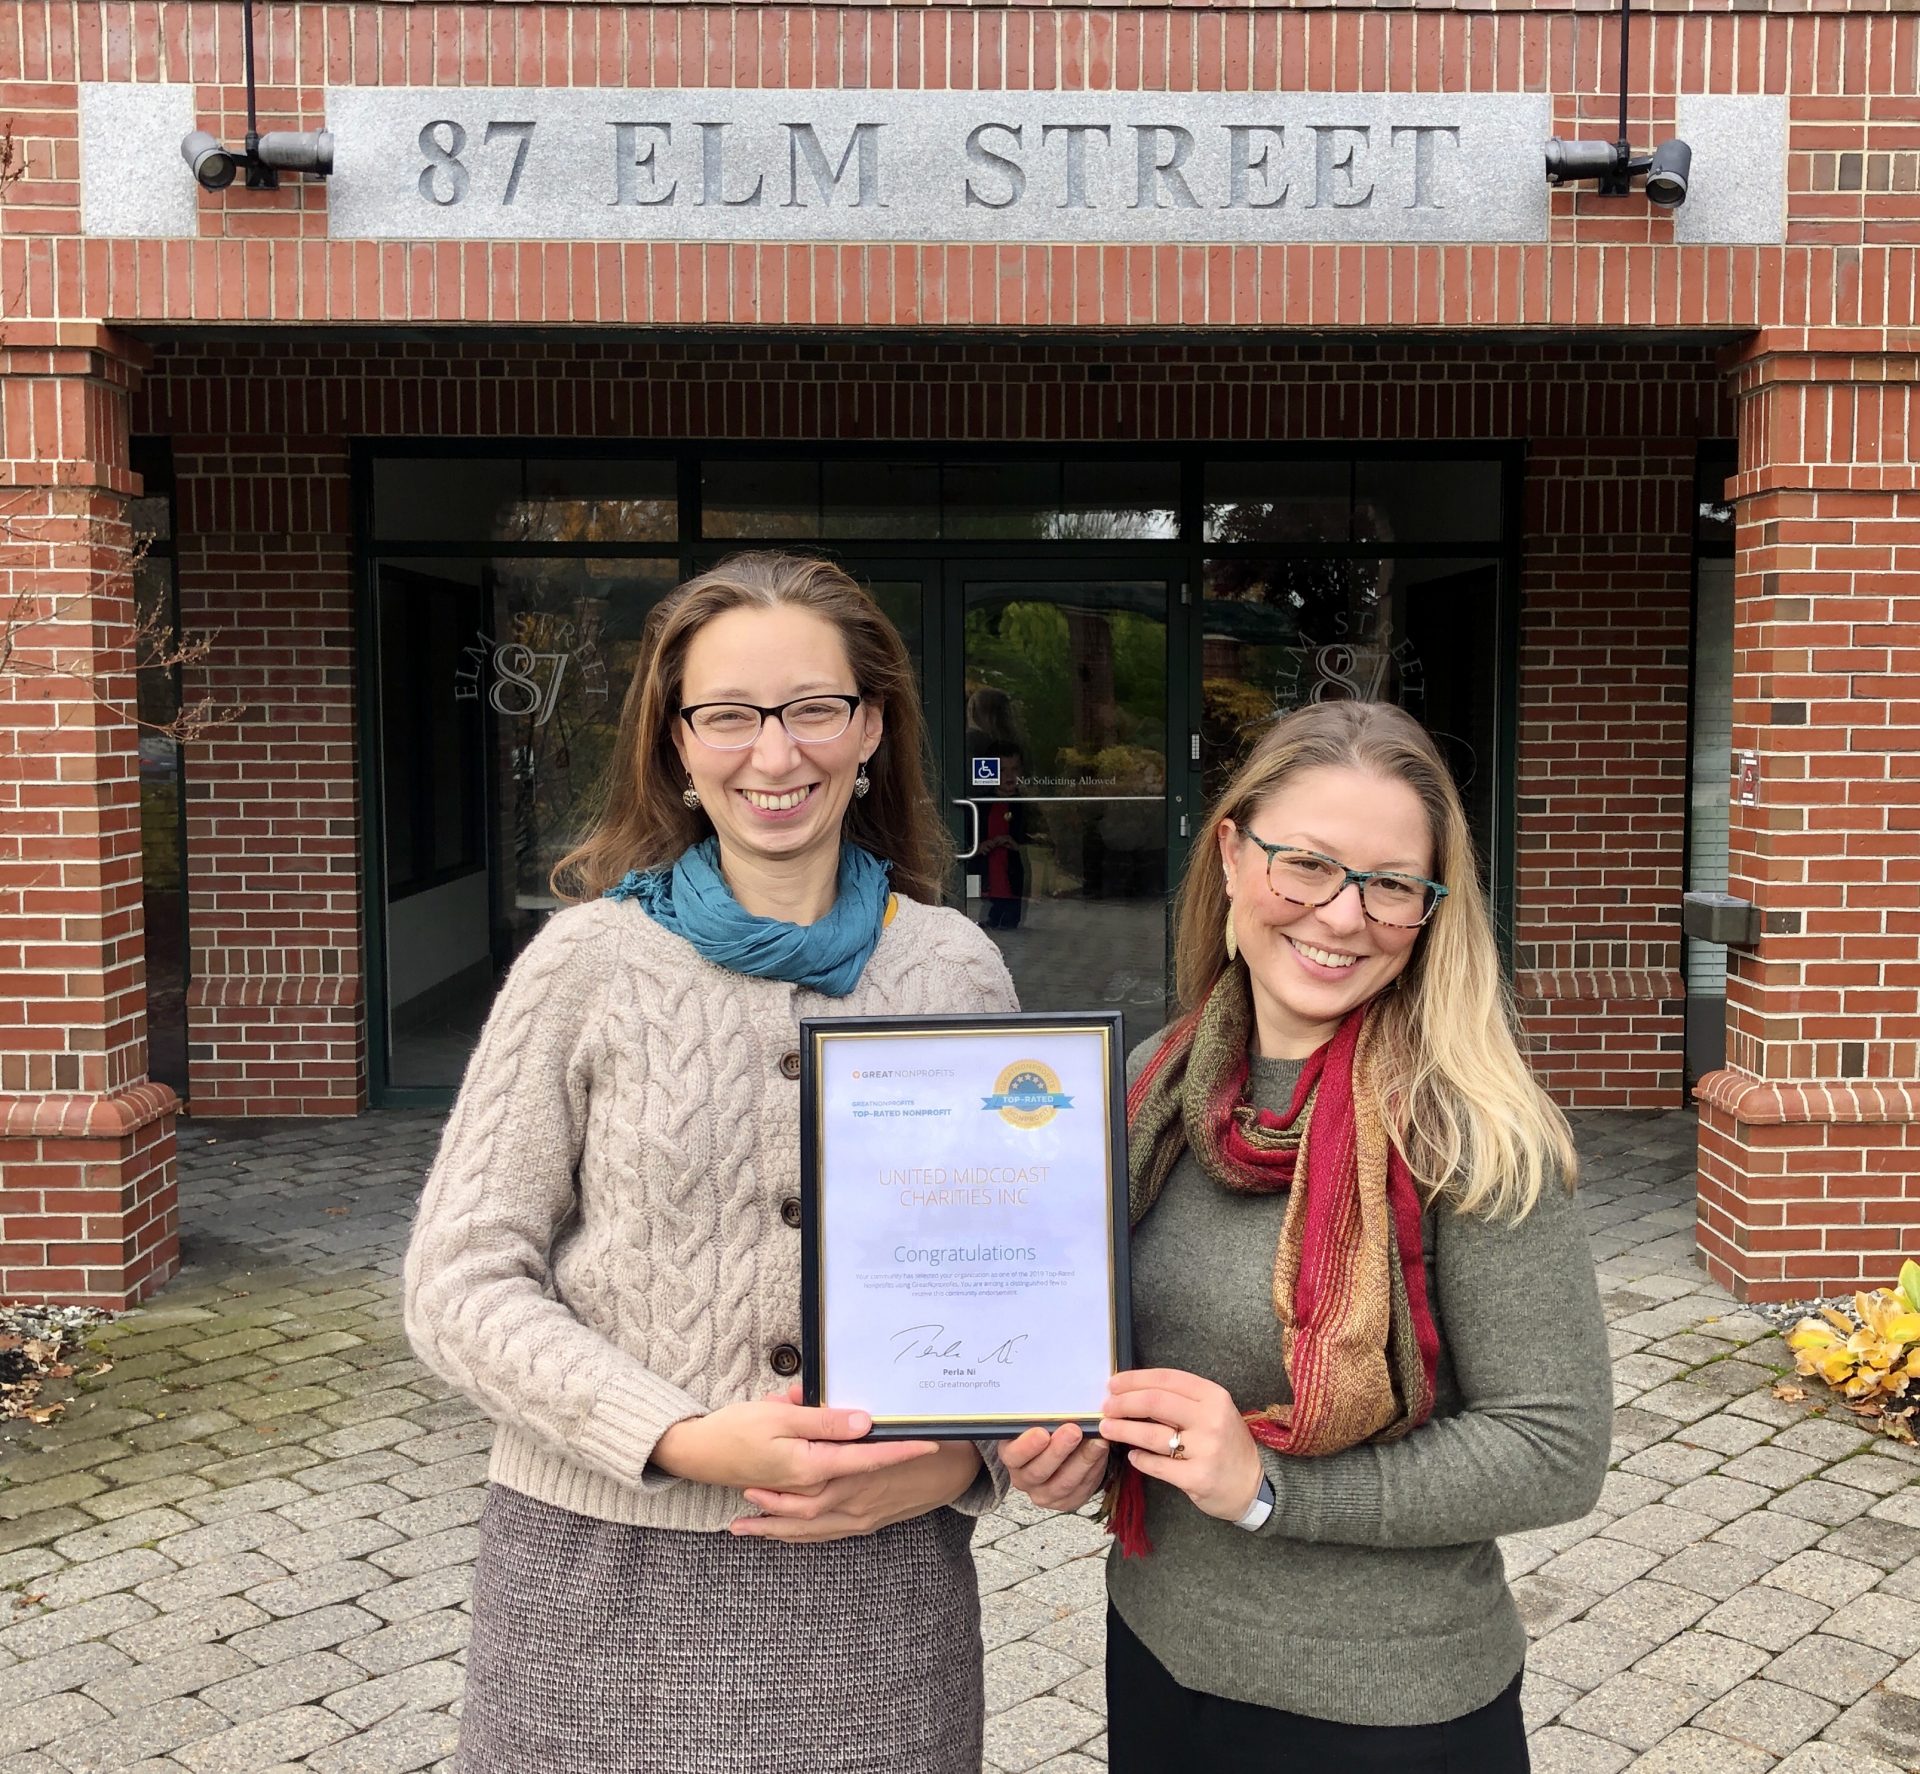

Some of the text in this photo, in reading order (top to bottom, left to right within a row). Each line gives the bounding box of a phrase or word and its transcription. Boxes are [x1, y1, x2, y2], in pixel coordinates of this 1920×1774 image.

[418, 119, 1461, 209] 87 ELM STREET
[454, 611, 609, 702] ELM STREET
[1275, 611, 1425, 700] ELM STREET
[1310, 643, 1391, 703] 87
[489, 643, 569, 727] 87
[1016, 776, 1116, 786] No Soliciting Allowed
[861, 1069, 955, 1079] GREATNONPROFITS
[1003, 1095, 1054, 1104] TOP-RATED
[852, 1108, 952, 1118] TOP-RATED NONPROFIT
[879, 1166, 1050, 1186] UNITED MIDCOAST
[900, 1188, 1029, 1206] CHARITIES INC
[894, 1244, 1036, 1267] Congratulations
[943, 1368, 976, 1376] Perla Ni
[919, 1379, 1001, 1390] CEO Greatnonprofits
